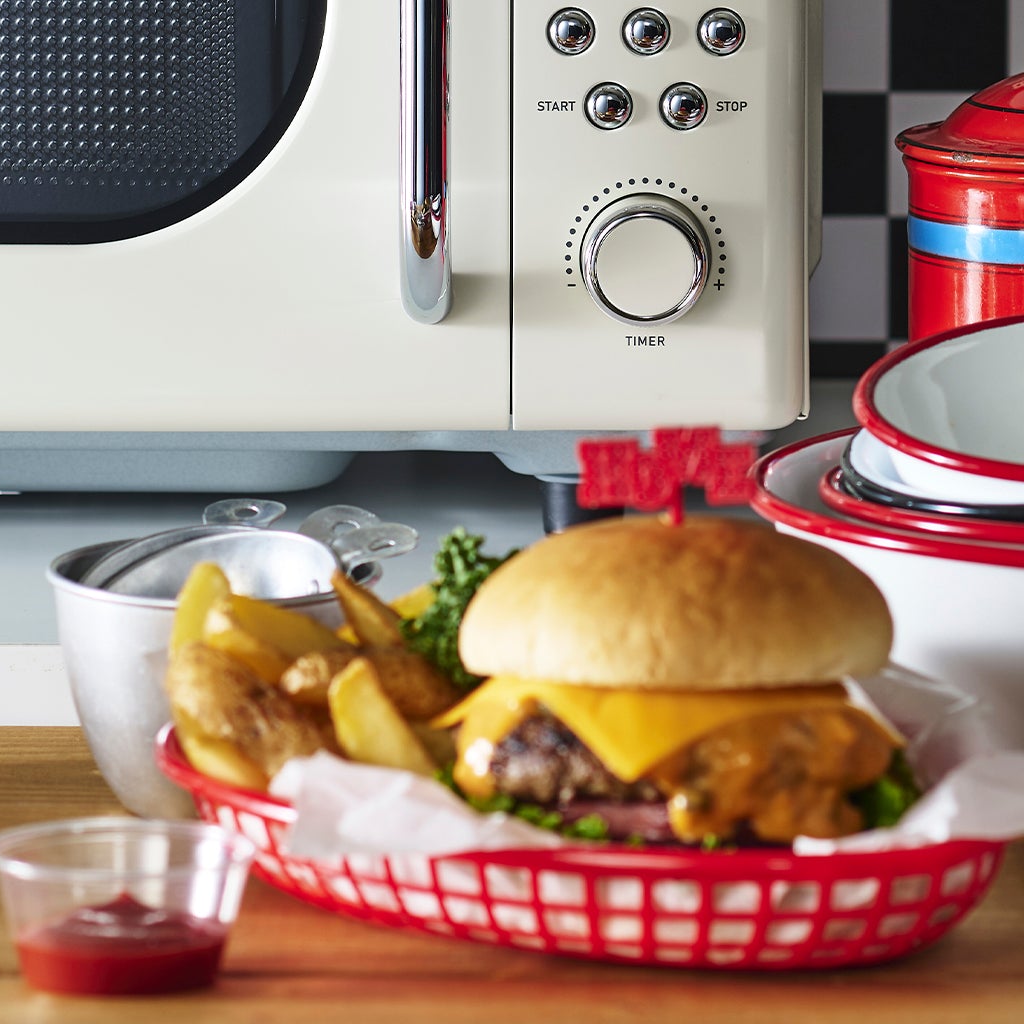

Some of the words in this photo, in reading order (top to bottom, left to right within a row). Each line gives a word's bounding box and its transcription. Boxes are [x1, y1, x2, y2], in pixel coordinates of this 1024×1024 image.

[536, 100, 577, 112] START
[715, 100, 748, 112] STOP
[624, 335, 666, 347] TIMER
